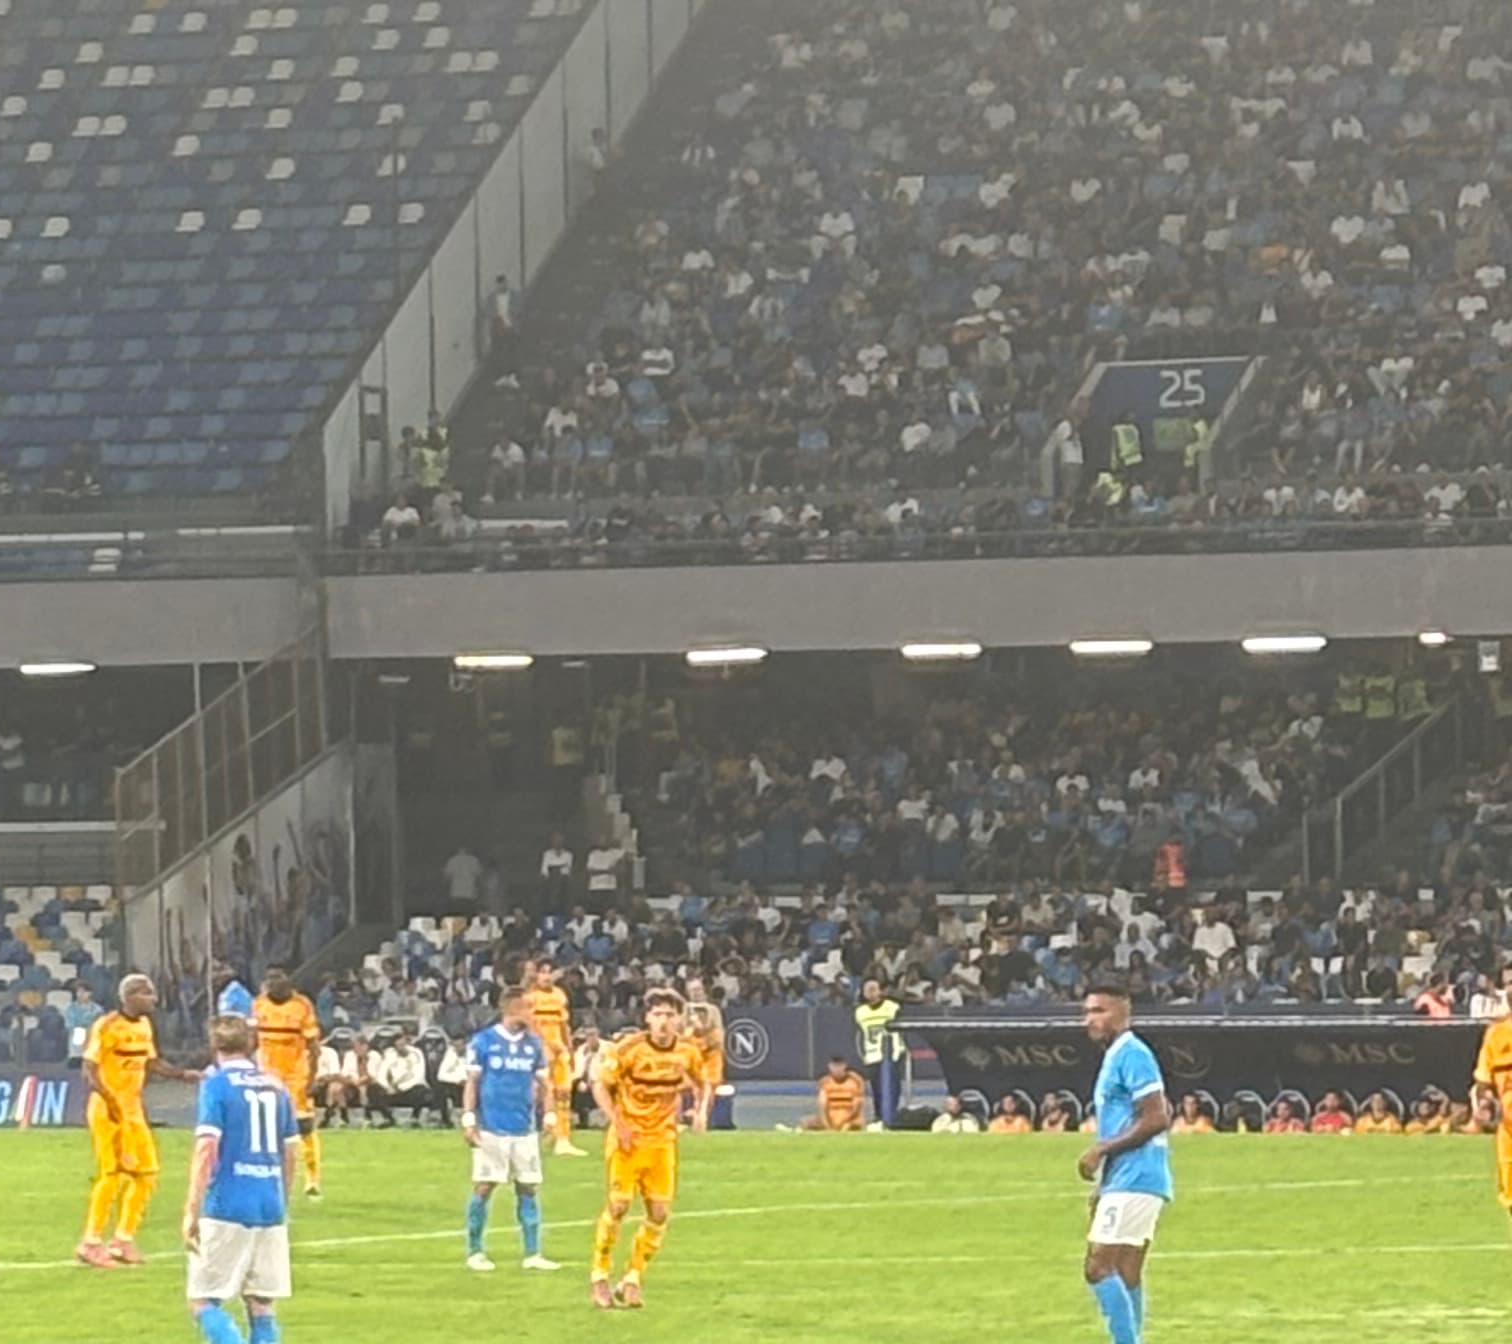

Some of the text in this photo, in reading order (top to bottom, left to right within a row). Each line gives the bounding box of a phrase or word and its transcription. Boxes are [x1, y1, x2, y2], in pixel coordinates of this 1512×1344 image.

[1159, 368, 1206, 408] 25
[734, 1032, 757, 1054] N
[999, 1041, 1078, 1066] MSC
[1329, 1041, 1417, 1064] MSC
[243, 1089, 278, 1153] 11
